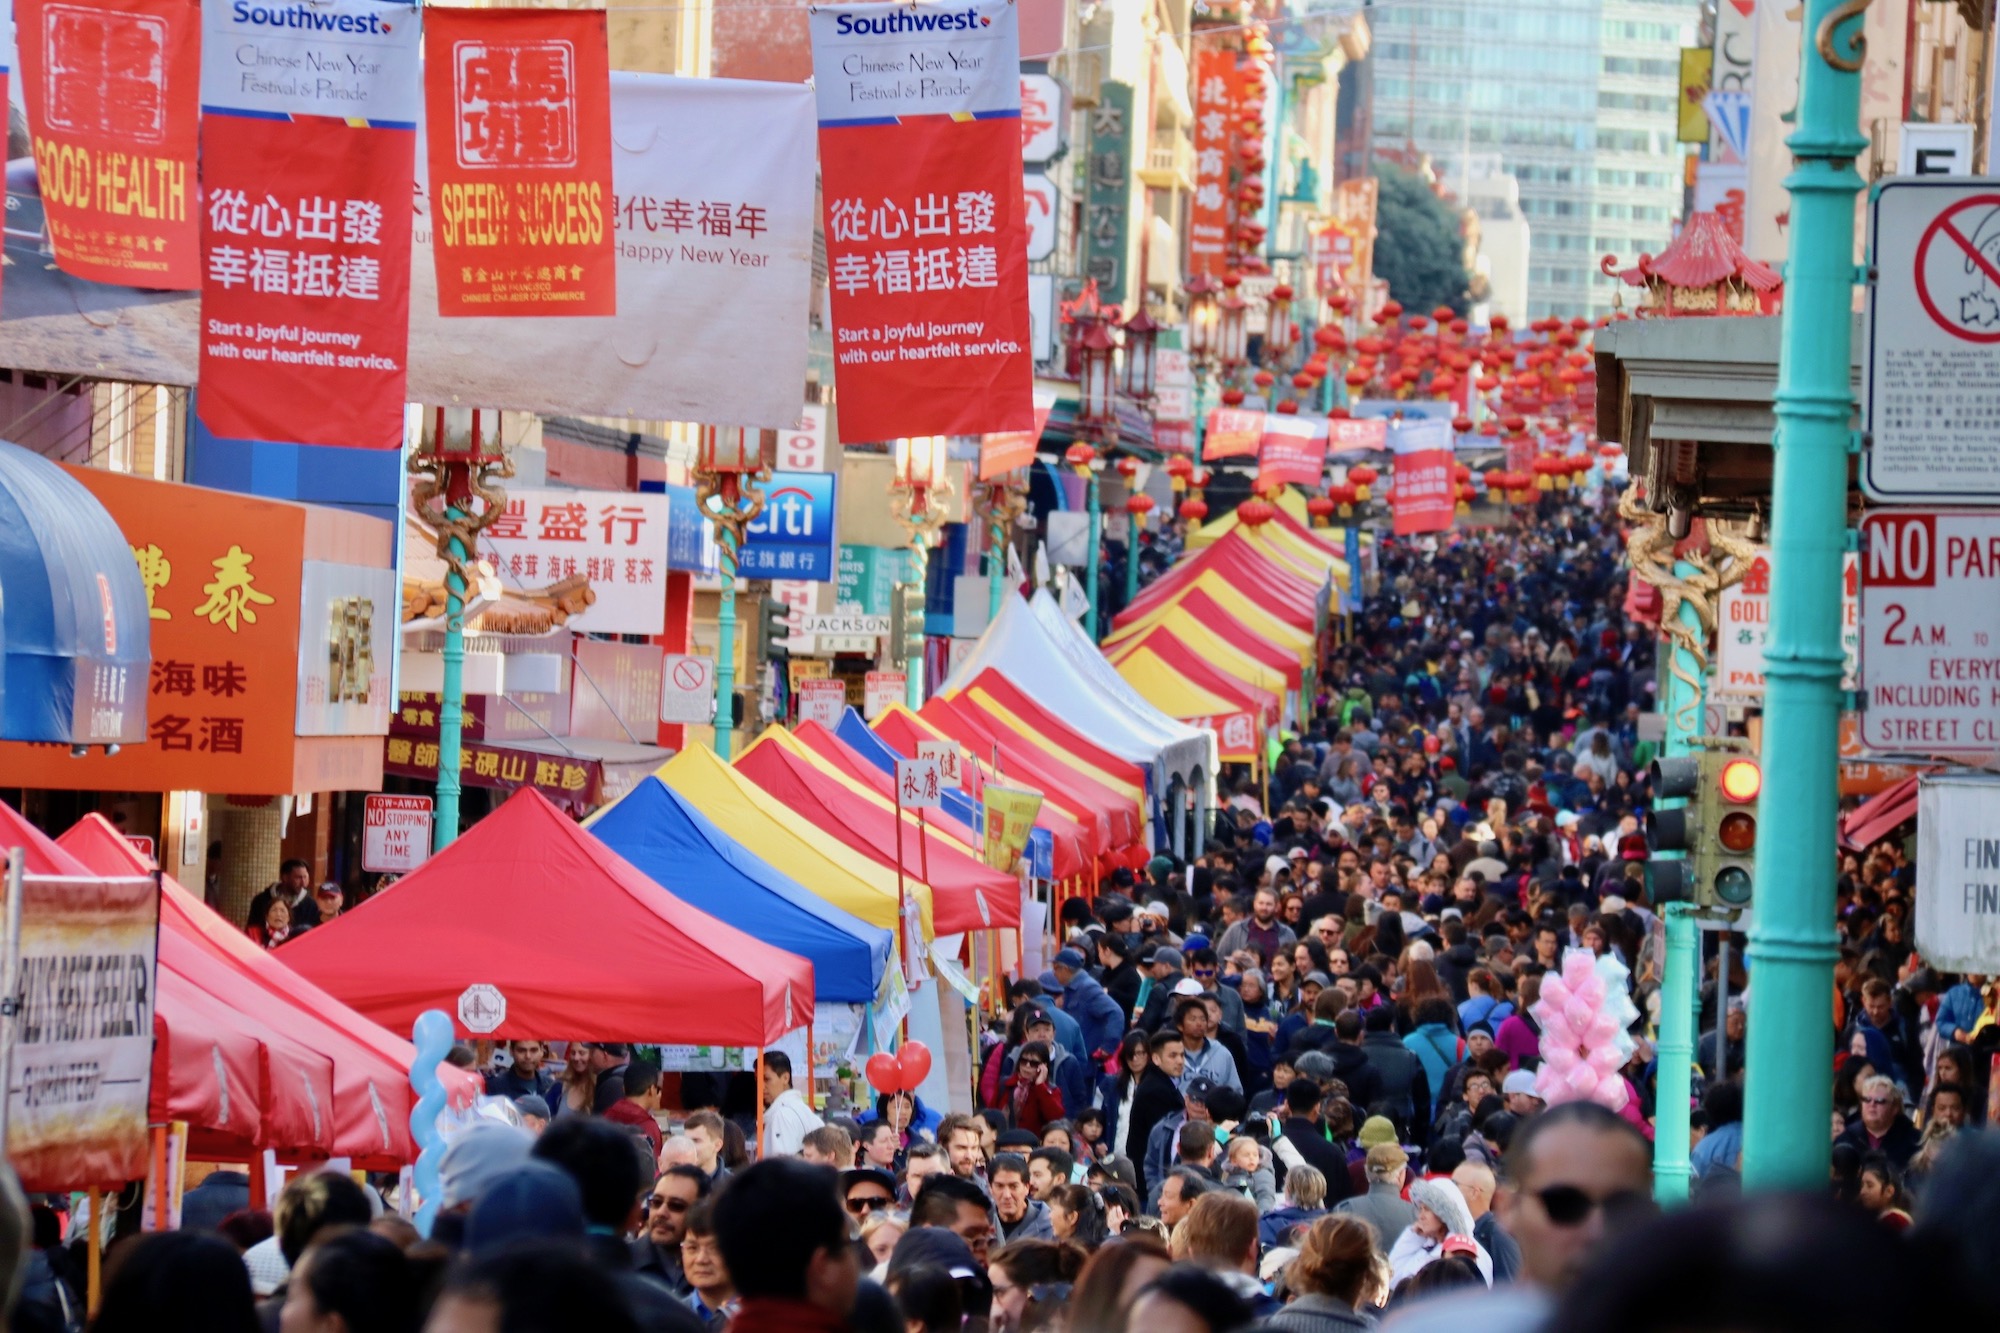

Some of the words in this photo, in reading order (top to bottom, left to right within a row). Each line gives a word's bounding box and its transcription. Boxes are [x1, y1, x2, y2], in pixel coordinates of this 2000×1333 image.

[232, 1, 380, 34] Southwest
[836, 8, 977, 35] Southwest
[236, 44, 301, 68] Chinese
[306, 51, 343, 72] New
[346, 54, 381, 75] Year
[842, 54, 904, 76] Chinese
[909, 53, 945, 73] New
[948, 50, 984, 72] Year
[241, 72, 297, 96] Festival
[300, 82, 312, 96] &
[316, 78, 368, 101] Parade
[850, 81, 900, 102] Festival
[905, 85, 917, 99] &
[920, 79, 971, 99] Parade
[35, 136, 91, 209] GOOD
[96, 150, 186, 222] HEALTH
[209, 188, 383, 246] 從心出發
[442, 182, 509, 247] SPEEDY
[516, 181, 604, 246] SUCCESS
[830, 190, 996, 243] 從心出發
[614, 241, 674, 264] Happy
[681, 244, 724, 264] New
[729, 247, 769, 267] Year
[209, 245, 381, 300] 幸福抵達
[834, 244, 998, 296] 幸福抵達
[208, 319, 242, 336] Start
[245, 326, 254, 338] a
[256, 323, 299, 343] joyful
[301, 327, 361, 350] journey
[838, 328, 869, 343] Start
[872, 330, 881, 341] a
[883, 322, 925, 344] joyful
[928, 322, 984, 341] journey
[208, 342, 238, 358] with
[242, 349, 267, 361] our
[272, 347, 334, 367] heartfelt
[338, 353, 397, 370] service.
[839, 348, 868, 364] with
[872, 350, 896, 362] our
[899, 342, 961, 360] heartfelt
[964, 339, 1022, 356] service.
[745, 495, 813, 536] citi
[739, 550, 815, 570] 花旗銀行
[1870, 520, 1930, 580] NO
[805, 619, 890, 632] JACKSON
[1884, 603, 1907, 645] 2
[1974, 632, 1989, 646] TO
[151, 659, 247, 698] 海味
[1875, 686, 1980, 707] INCLUDING
[150, 714, 244, 754] 名酒
[1881, 719, 1960, 741] STREET
[903, 767, 939, 800] 永康
[367, 808, 385, 826] NO
[387, 813, 428, 828] STOPPING
[372, 798, 426, 809] TOW-AWAY
[383, 844, 410, 857] TIME
[385, 829, 410, 842] ANY
[1963, 883, 2000, 915] FIN
